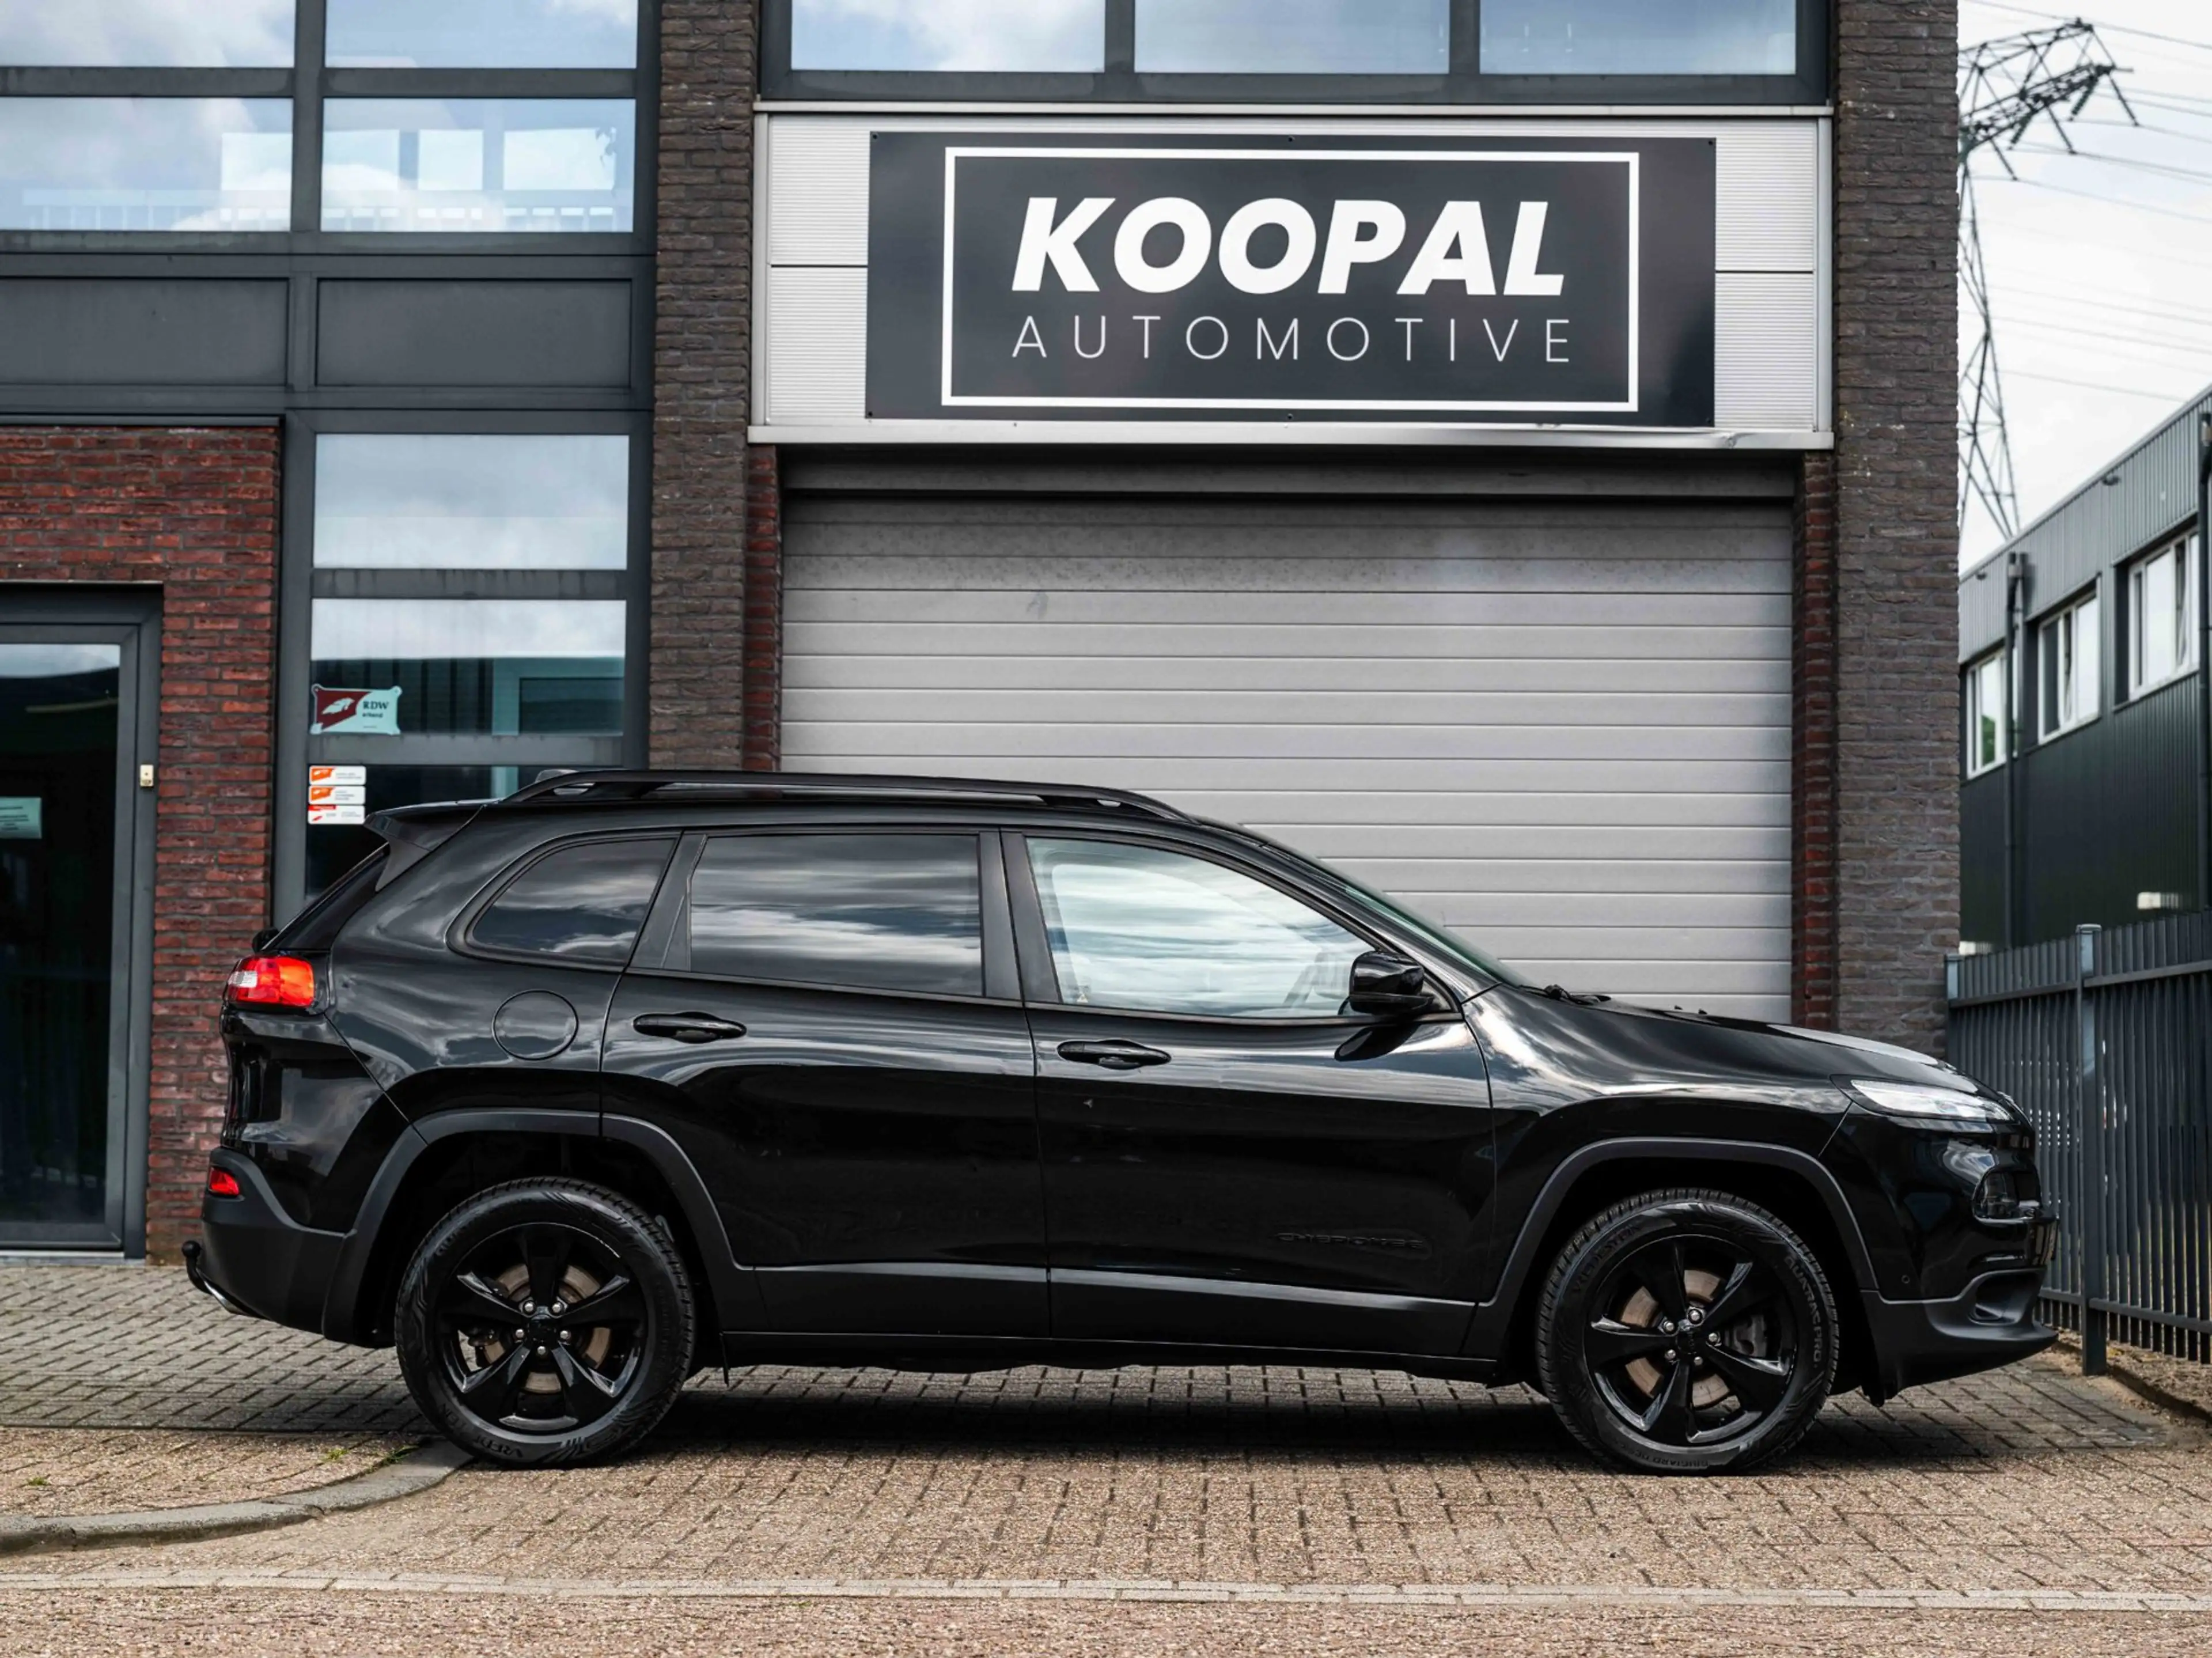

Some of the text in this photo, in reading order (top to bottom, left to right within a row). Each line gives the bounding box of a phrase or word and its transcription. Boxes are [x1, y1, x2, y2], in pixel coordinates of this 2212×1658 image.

[1012, 197, 1564, 295] KOOPAL
[1012, 315, 1569, 363] AUTOMOTIVE
[363, 701, 389, 709] RDW
[1784, 1255, 1822, 1324] QUATRAC
